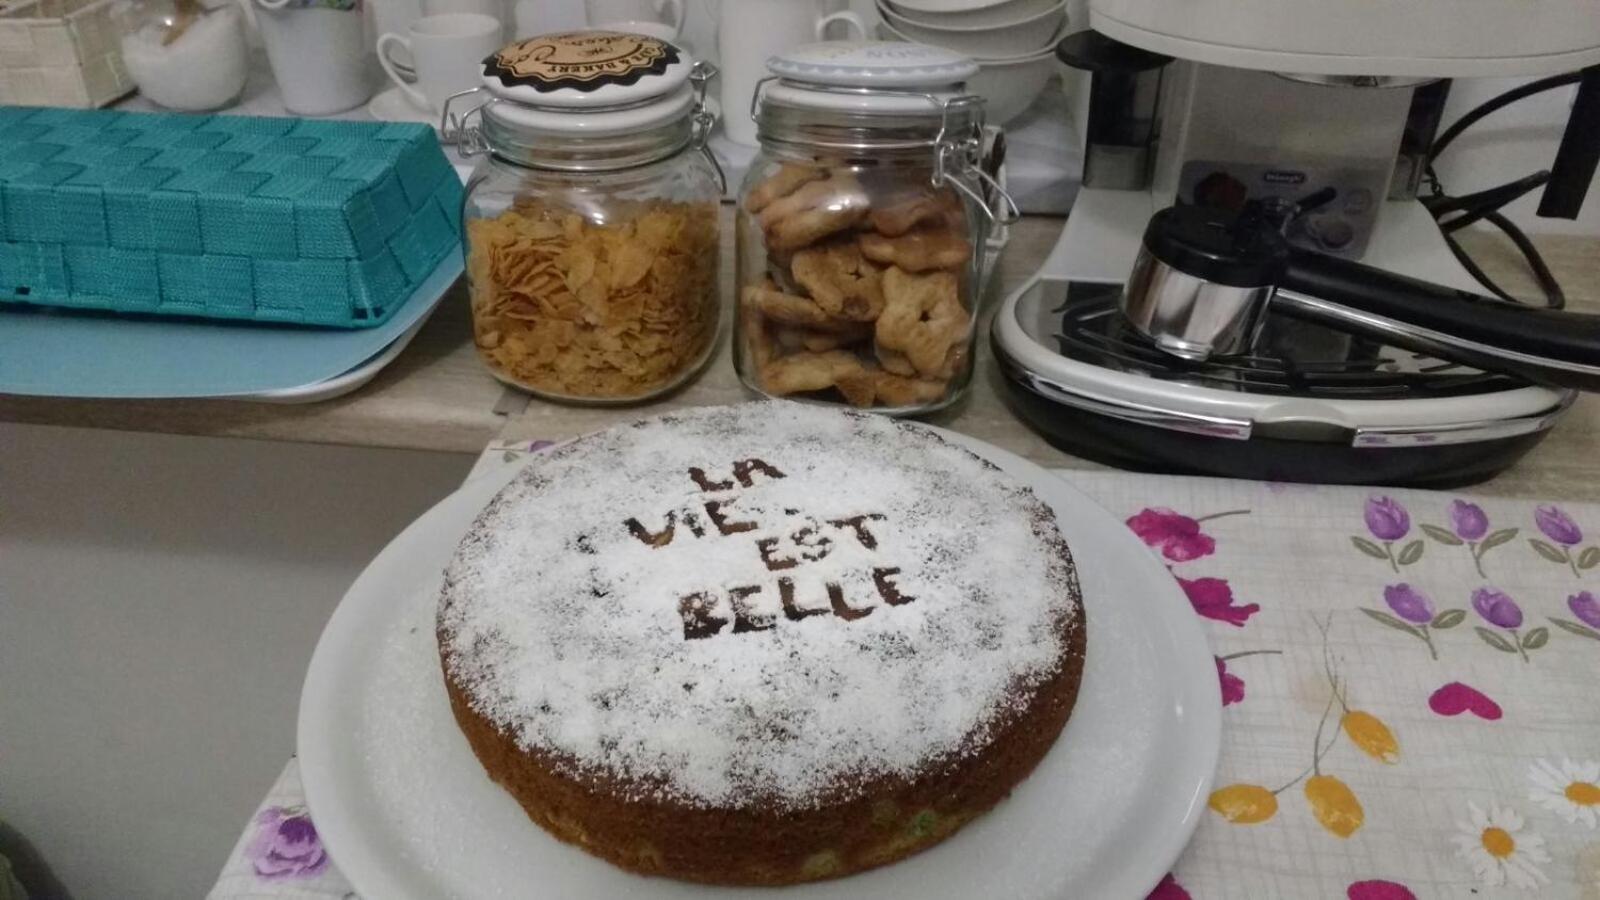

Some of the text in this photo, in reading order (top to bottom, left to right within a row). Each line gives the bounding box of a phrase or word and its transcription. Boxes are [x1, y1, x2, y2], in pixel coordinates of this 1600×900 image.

[547, 62, 617, 73] BAKERY
[688, 458, 787, 492] LA
[622, 501, 759, 549] VIE
[755, 513, 887, 571] EST
[677, 567, 916, 640] BELLE
